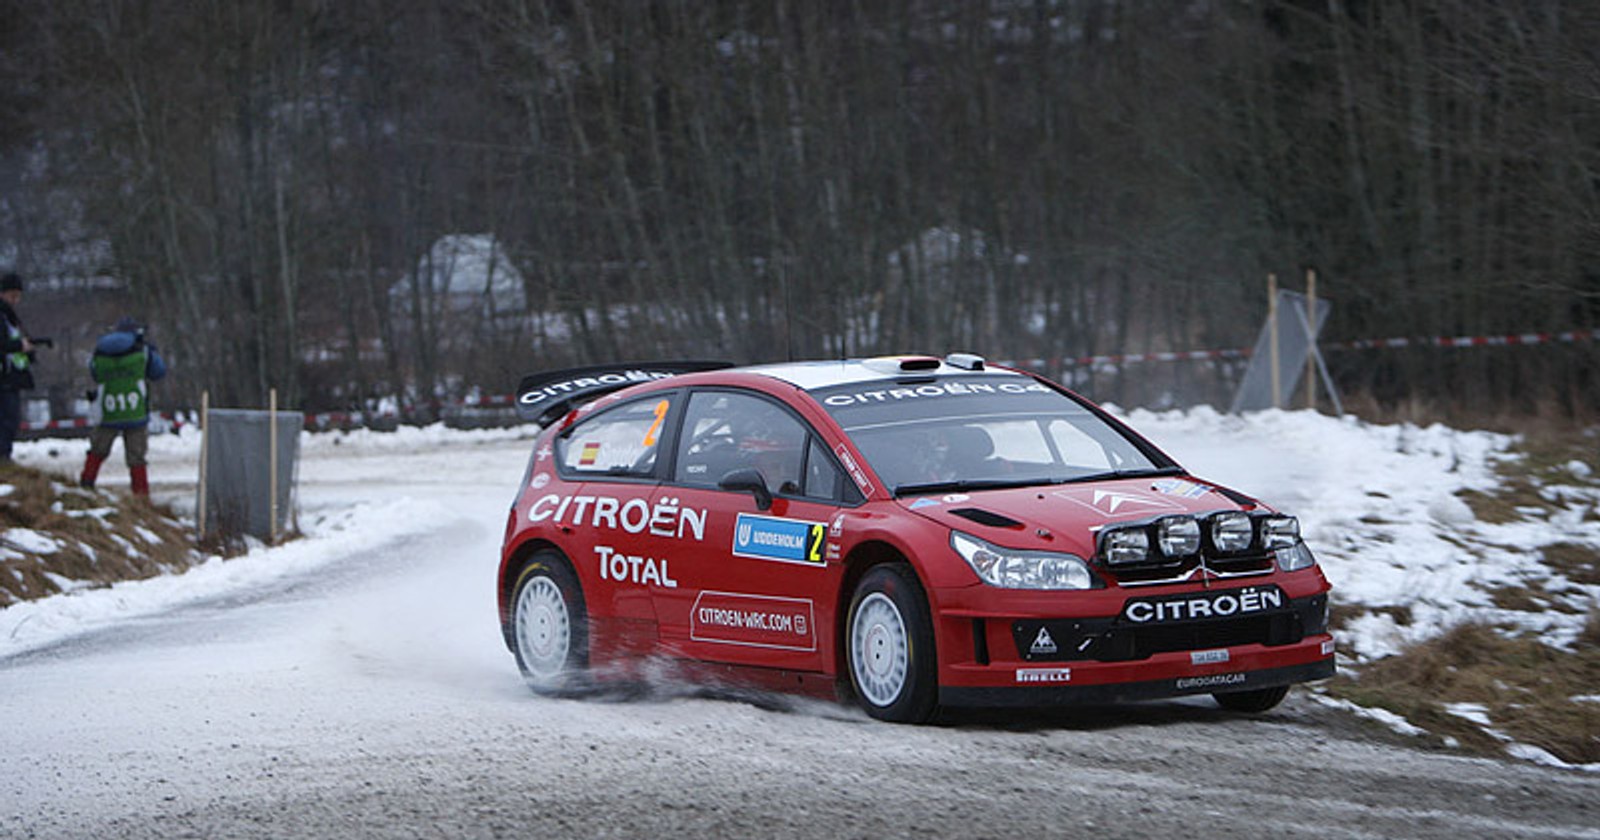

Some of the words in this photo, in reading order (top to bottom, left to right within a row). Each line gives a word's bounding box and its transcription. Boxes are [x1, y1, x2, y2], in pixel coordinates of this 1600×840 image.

[105, 391, 139, 412] 019
[824, 382, 995, 405] CITROËN
[998, 383, 1051, 394] C4
[643, 399, 670, 446] 2
[528, 494, 708, 541] CITROËN
[809, 523, 824, 562] 2
[699, 607, 793, 631] CITROEN-WRC.COM
[1125, 588, 1281, 622] CITROËN
